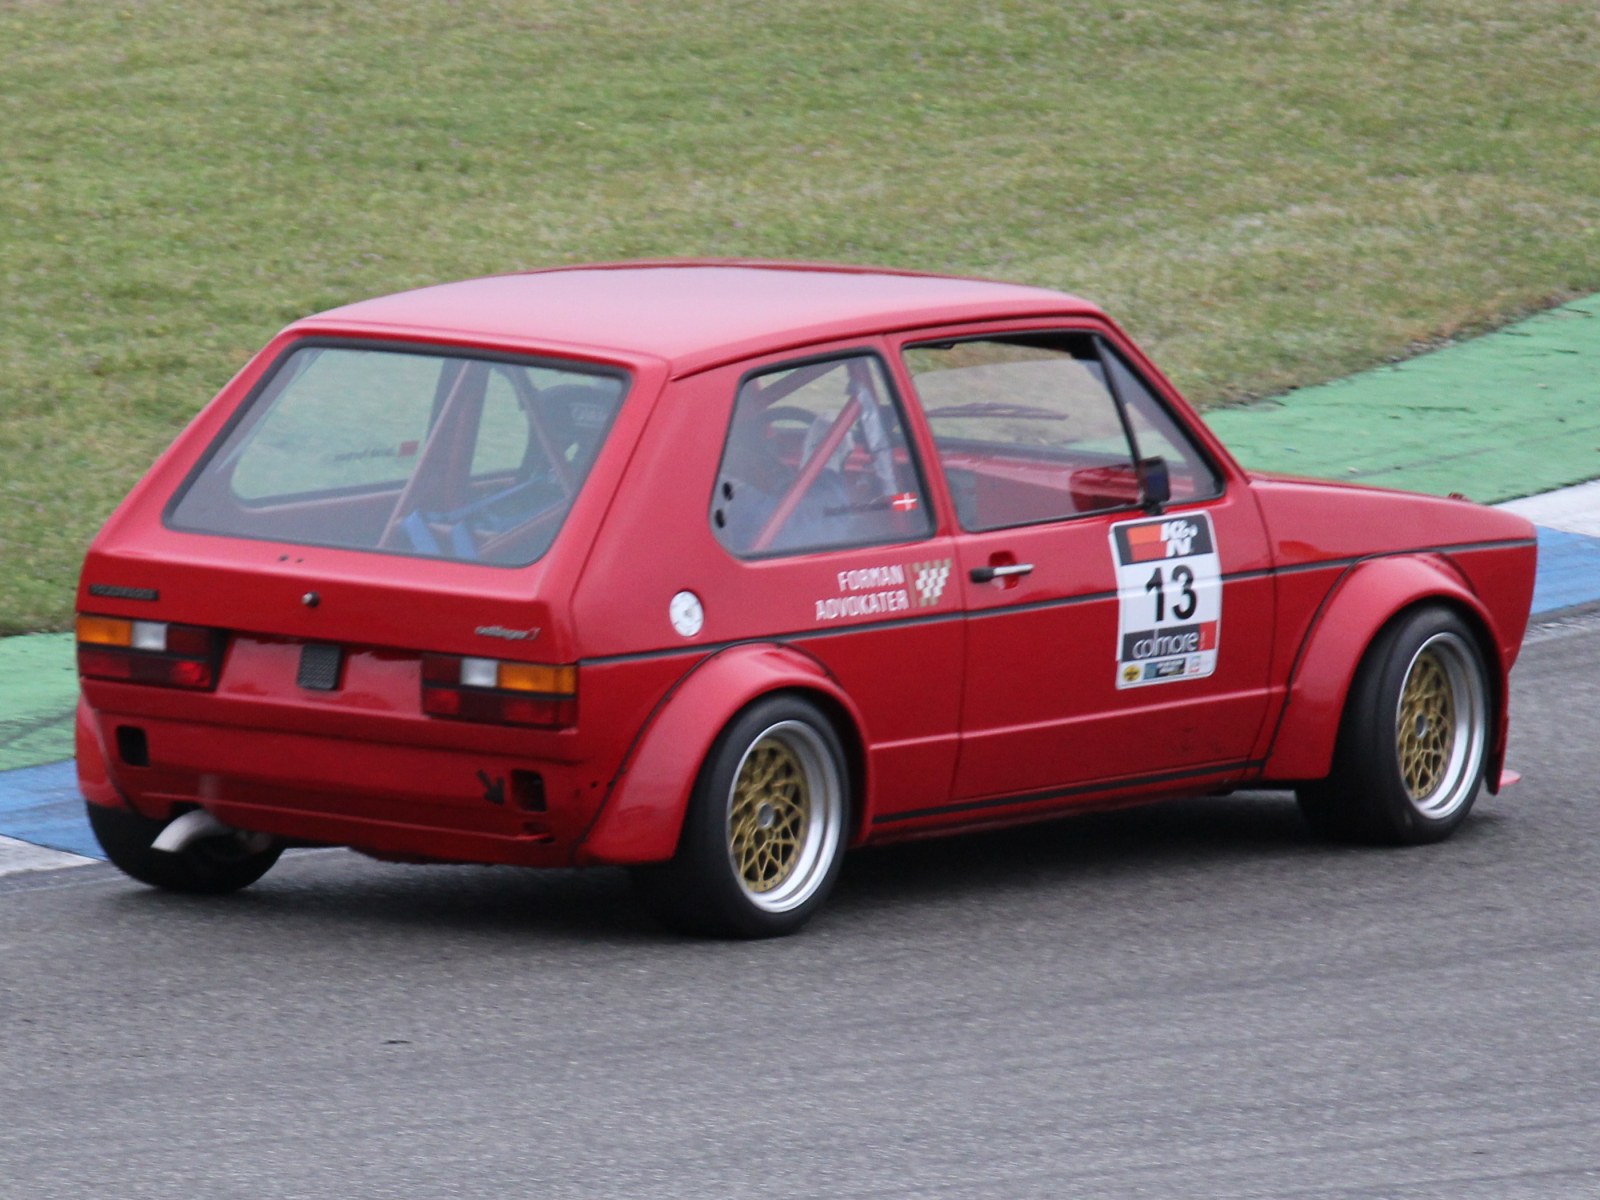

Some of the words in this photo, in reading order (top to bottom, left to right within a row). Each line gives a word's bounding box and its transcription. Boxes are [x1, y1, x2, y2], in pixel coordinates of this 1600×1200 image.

[838, 564, 905, 592] FORMAN
[1145, 564, 1198, 622] 13
[815, 589, 909, 620] ADVOKATER
[1132, 629, 1199, 659] colmore
